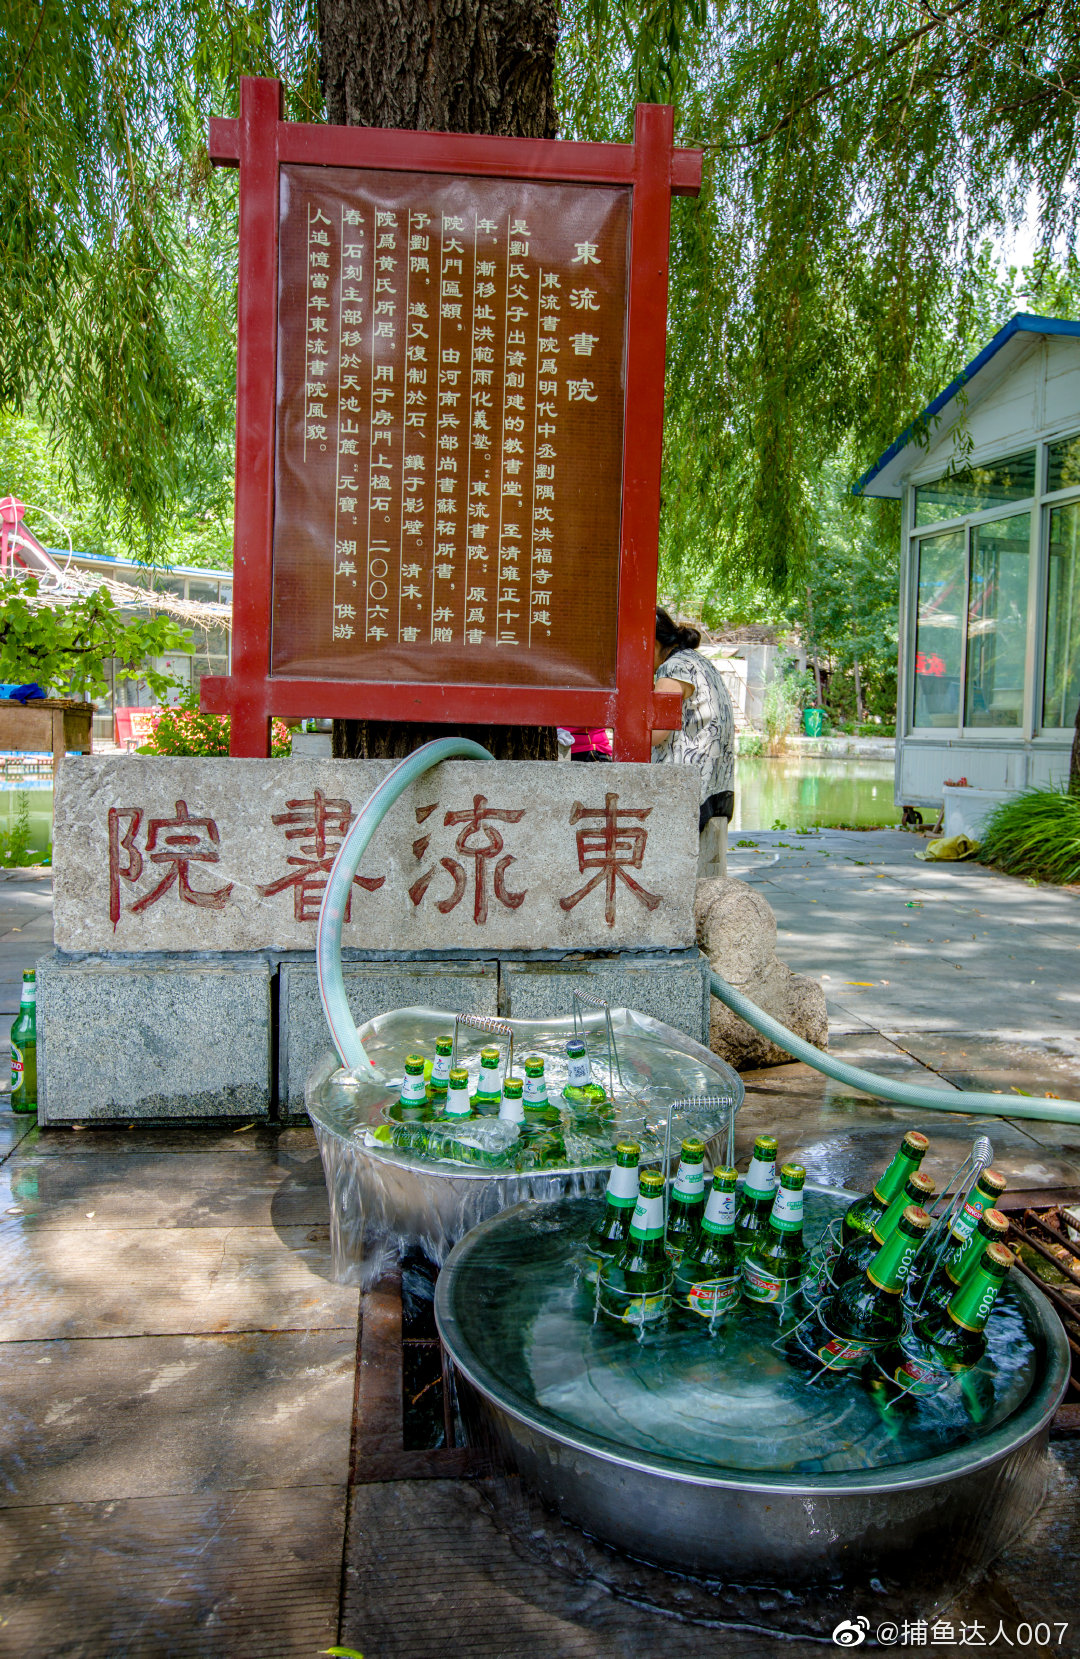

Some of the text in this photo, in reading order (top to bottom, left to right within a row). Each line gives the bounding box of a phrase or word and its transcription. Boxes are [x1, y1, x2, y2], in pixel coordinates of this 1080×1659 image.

[565, 240, 602, 404] 東流書院
[895, 1247, 917, 1281] 1903
[976, 1285, 998, 1321] 1903
